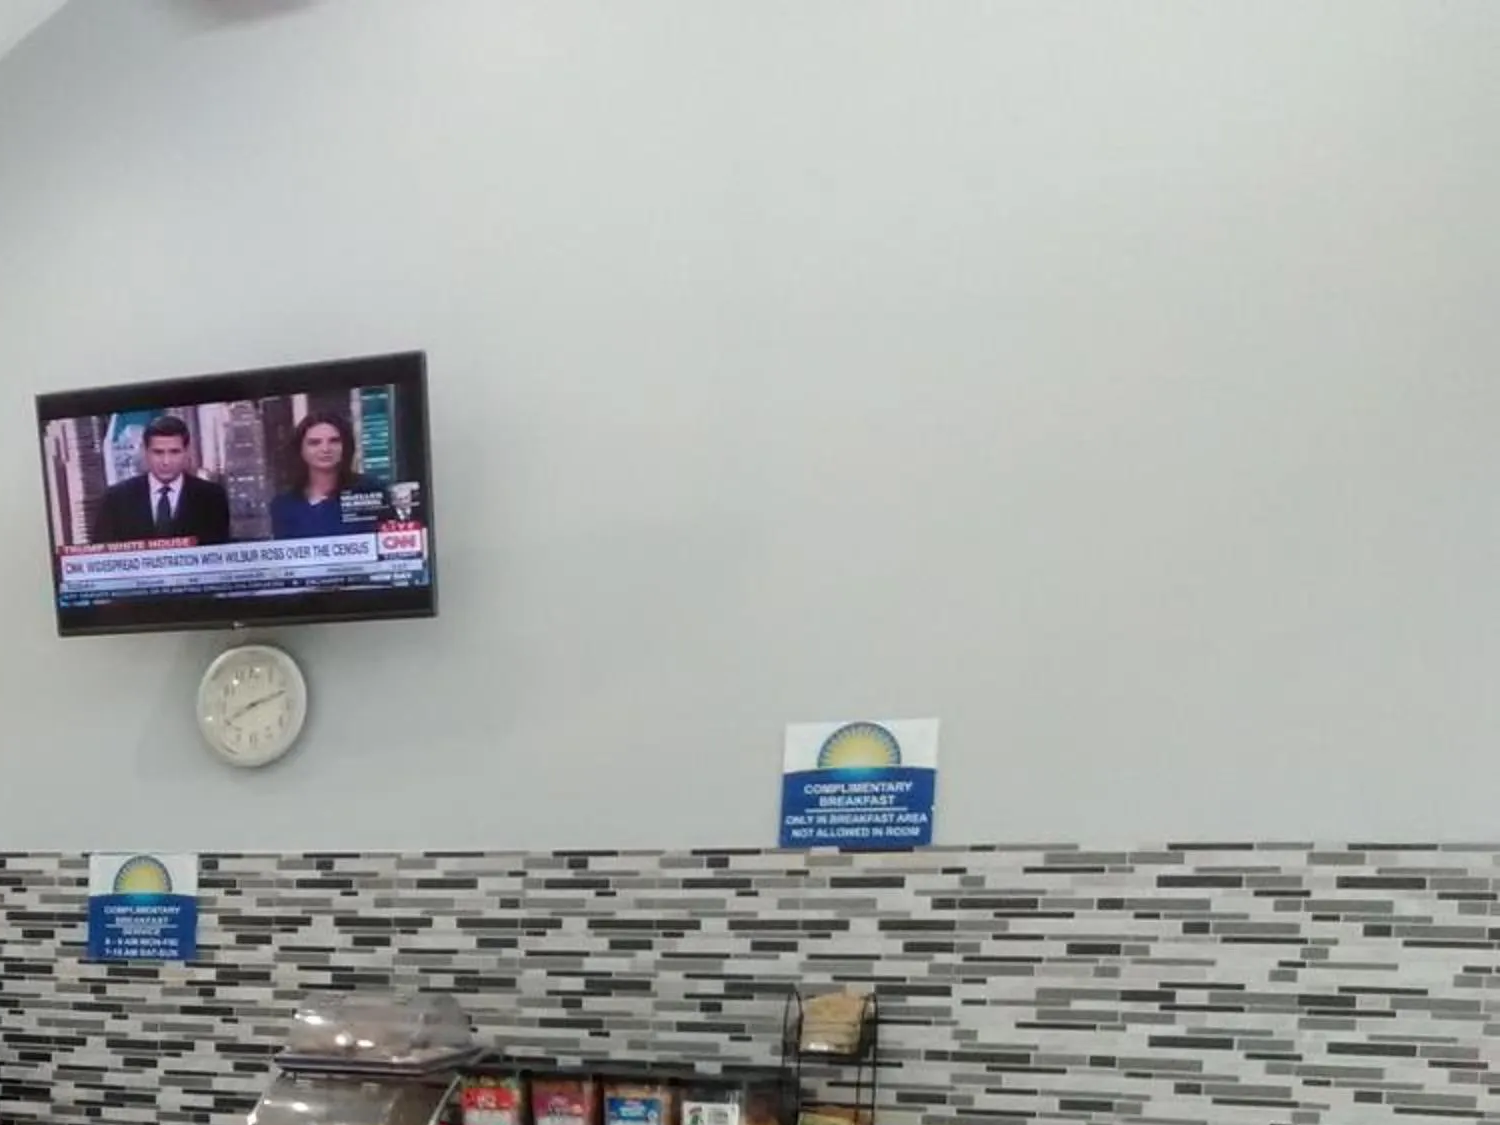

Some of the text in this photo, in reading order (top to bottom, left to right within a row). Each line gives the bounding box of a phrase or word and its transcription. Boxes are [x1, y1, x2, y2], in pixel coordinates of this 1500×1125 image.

[382, 535, 416, 550] CNN
[142, 554, 198, 569] FRUSTRATION
[200, 552, 222, 565] WITH
[225, 549, 258, 563] WILBUR
[260, 547, 285, 561] ROSS
[287, 545, 310, 559] OVER
[313, 544, 331, 557] THE
[332, 541, 369, 556] CENSUS
[803, 782, 912, 795] COMPLIMENTARY
[819, 796, 896, 807] BREAKFAST
[785, 813, 928, 825] ONLY IN BREAKFAST AREA
[791, 826, 921, 838] NOT ALLOWED IN ROOM
[103, 905, 181, 915] COMPLIMENTARY
[116, 916, 169, 925] BREAKFAST
